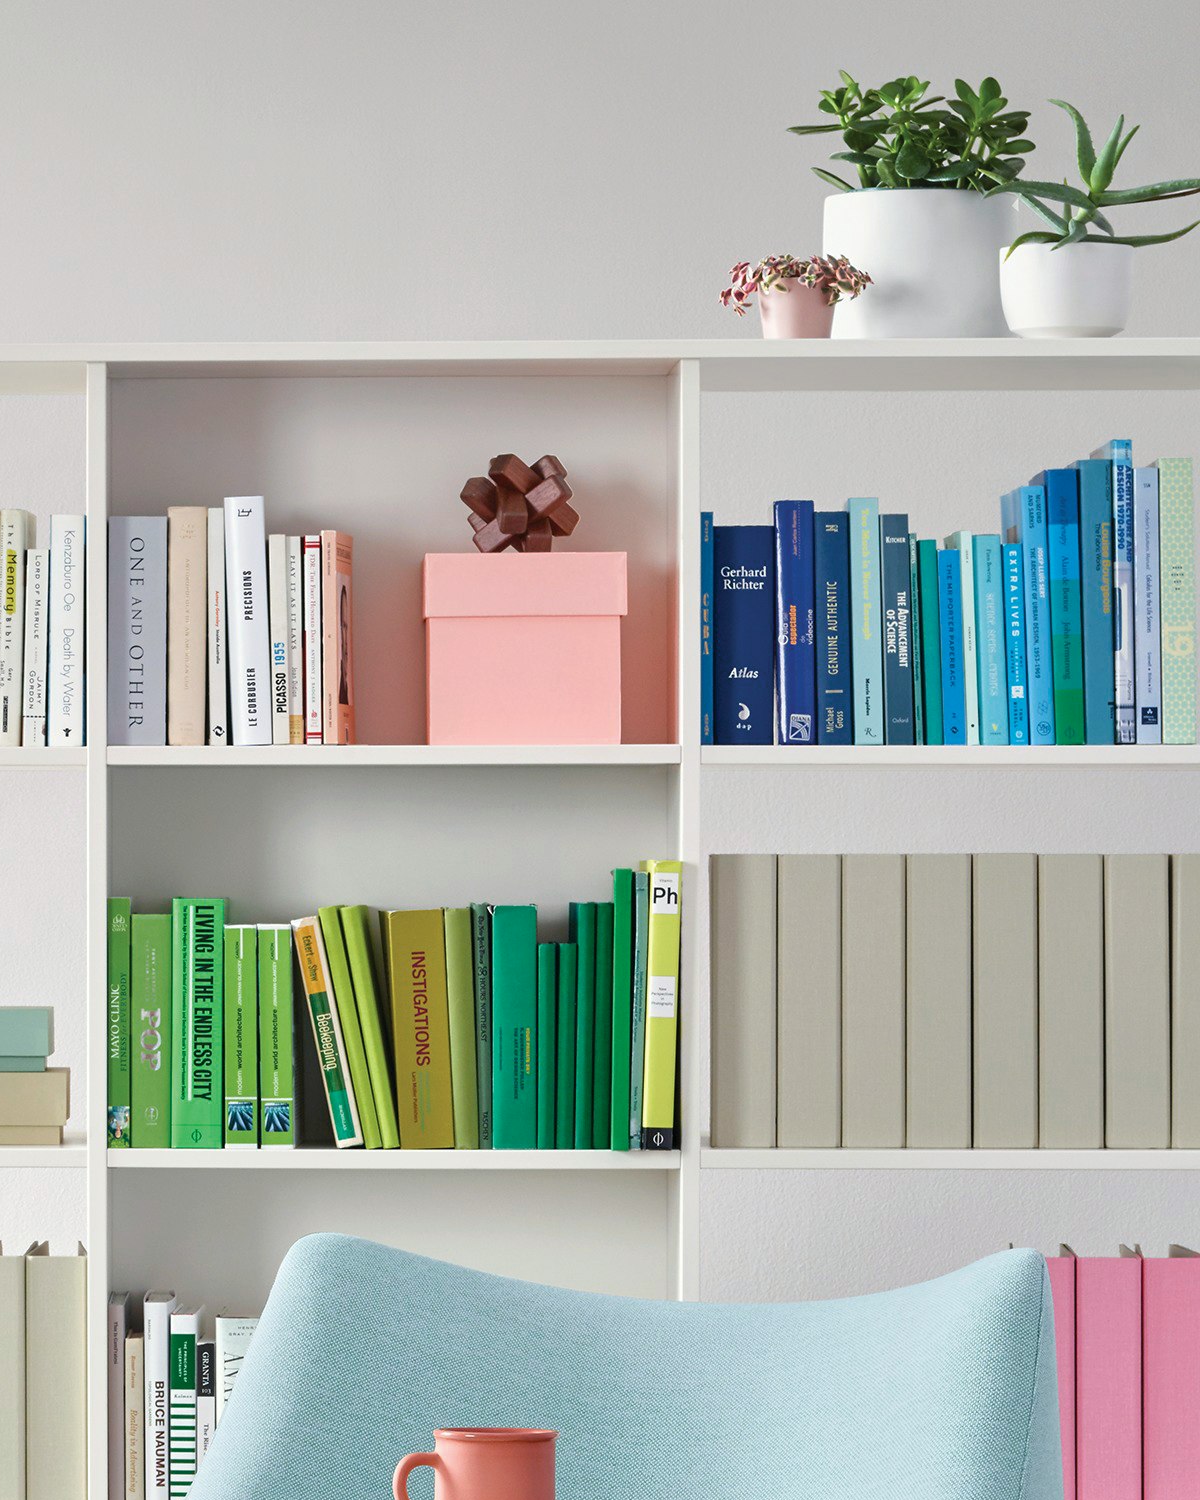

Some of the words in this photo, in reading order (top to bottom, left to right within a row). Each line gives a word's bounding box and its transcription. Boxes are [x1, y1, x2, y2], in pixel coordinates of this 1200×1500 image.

[1116, 465, 1125, 502] DESIGN
[1101, 522, 1110, 556] Louise
[34, 555, 42, 580] LORD
[63, 530, 76, 590] Kenzaburo
[129, 537, 145, 586] ONE
[720, 565, 767, 578] Gerhard
[1009, 550, 1018, 591] EXTRA
[4, 554, 17, 612] Memory
[34, 583, 41, 595] OF
[243, 570, 253, 620] PRECISIONS
[291, 583, 296, 591] IT
[723, 578, 764, 590] Richter
[897, 591, 907, 606] THE
[947, 582, 953, 594] MR
[1032, 592, 1037, 600] OF
[1101, 559, 1111, 614] Bourgeois
[33, 600, 41, 639] MISRULE
[63, 593, 75, 612] Oe
[130, 596, 143, 636] AND
[290, 598, 296, 607] AS
[291, 613, 296, 622] IT
[826, 581, 838, 631] AUTHENTIC
[886, 609, 895, 619] OF
[1010, 597, 1020, 637] LIVES
[789, 605, 797, 645] espectador
[805, 609, 813, 645] videocine
[886, 621, 898, 654] SCIENCE
[897, 608, 909, 668] ADVANCEMENT
[62, 628, 75, 661] Death
[273, 642, 285, 665] 1955
[828, 635, 839, 675] GENUINE
[60, 663, 75, 678] by
[128, 645, 144, 728] OTHER
[728, 667, 759, 678] Atlas
[62, 681, 74, 716] Water
[246, 667, 257, 714] CORBUSIER
[275, 672, 287, 713] PICASSO
[248, 717, 257, 727] LE
[825, 707, 834, 733] Michael
[835, 711, 844, 728] Gross
[653, 887, 678, 905] Ph
[195, 905, 214, 953] LIVING
[303, 935, 314, 957] Eckert
[195, 958, 214, 973] IN
[308, 964, 318, 982] Shaw
[110, 984, 120, 1022] CLINIC
[194, 975, 213, 1003] THE
[411, 951, 431, 1067] INSTIGATIONS
[110, 1026, 120, 1058] MAYO
[141, 1008, 161, 1071] POP
[193, 1007, 213, 1067] ENDLESS
[316, 1012, 339, 1071] Beekeeping
[193, 1069, 212, 1101] CITY
[201, 1352, 209, 1386] GRANTA
[154, 1380, 165, 1427] BRUCE
[131, 1438, 136, 1446] in
[155, 1430, 166, 1487] NAUMAN
[129, 1449, 138, 1493] Advertising
